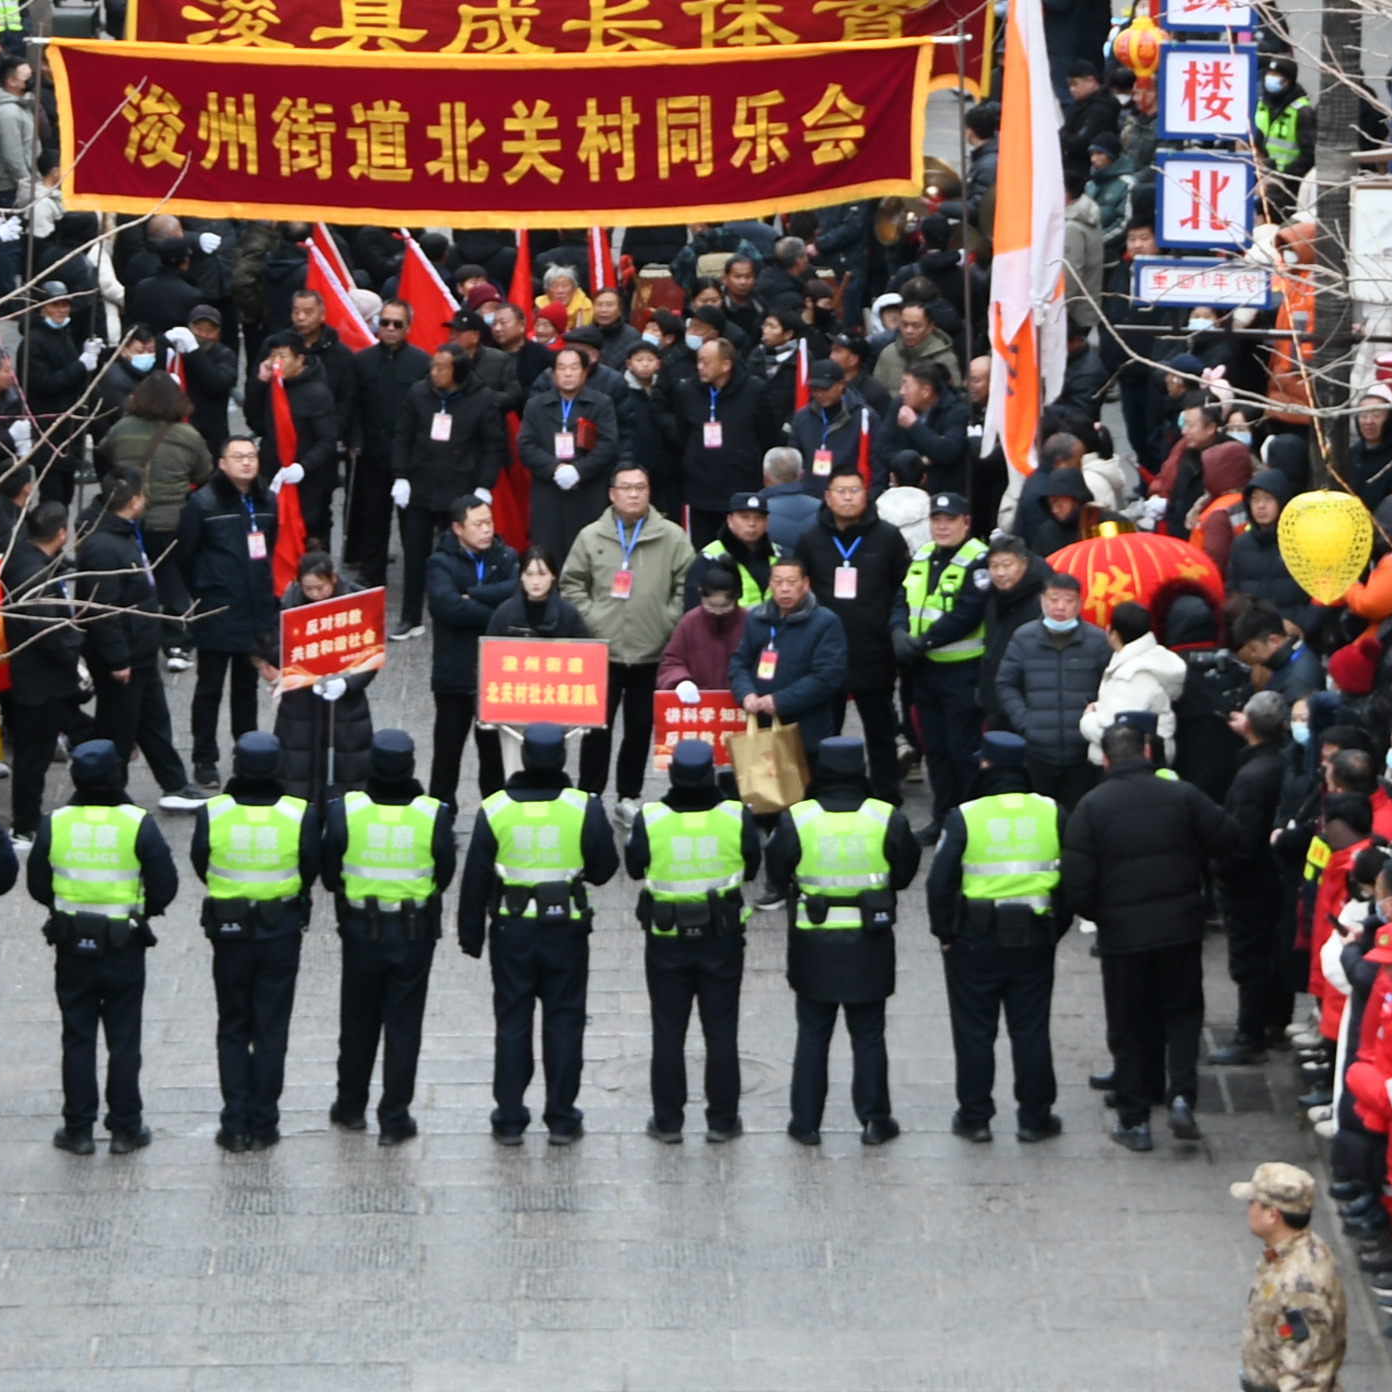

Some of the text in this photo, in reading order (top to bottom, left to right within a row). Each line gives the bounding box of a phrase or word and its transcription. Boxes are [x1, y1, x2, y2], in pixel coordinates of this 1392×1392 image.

[121, 82, 868, 186] 浚州街道北关村同乐会
[70, 822, 120, 850] 警察
[230, 824, 279, 851] 警察
[366, 822, 416, 850] 警察
[511, 824, 561, 851] 警察
[987, 817, 1037, 843] 警察
[65, 850, 120, 864] POLICE
[225, 851, 281, 864] POLICE
[361, 850, 416, 863] POLICE
[671, 835, 719, 861] 警察
